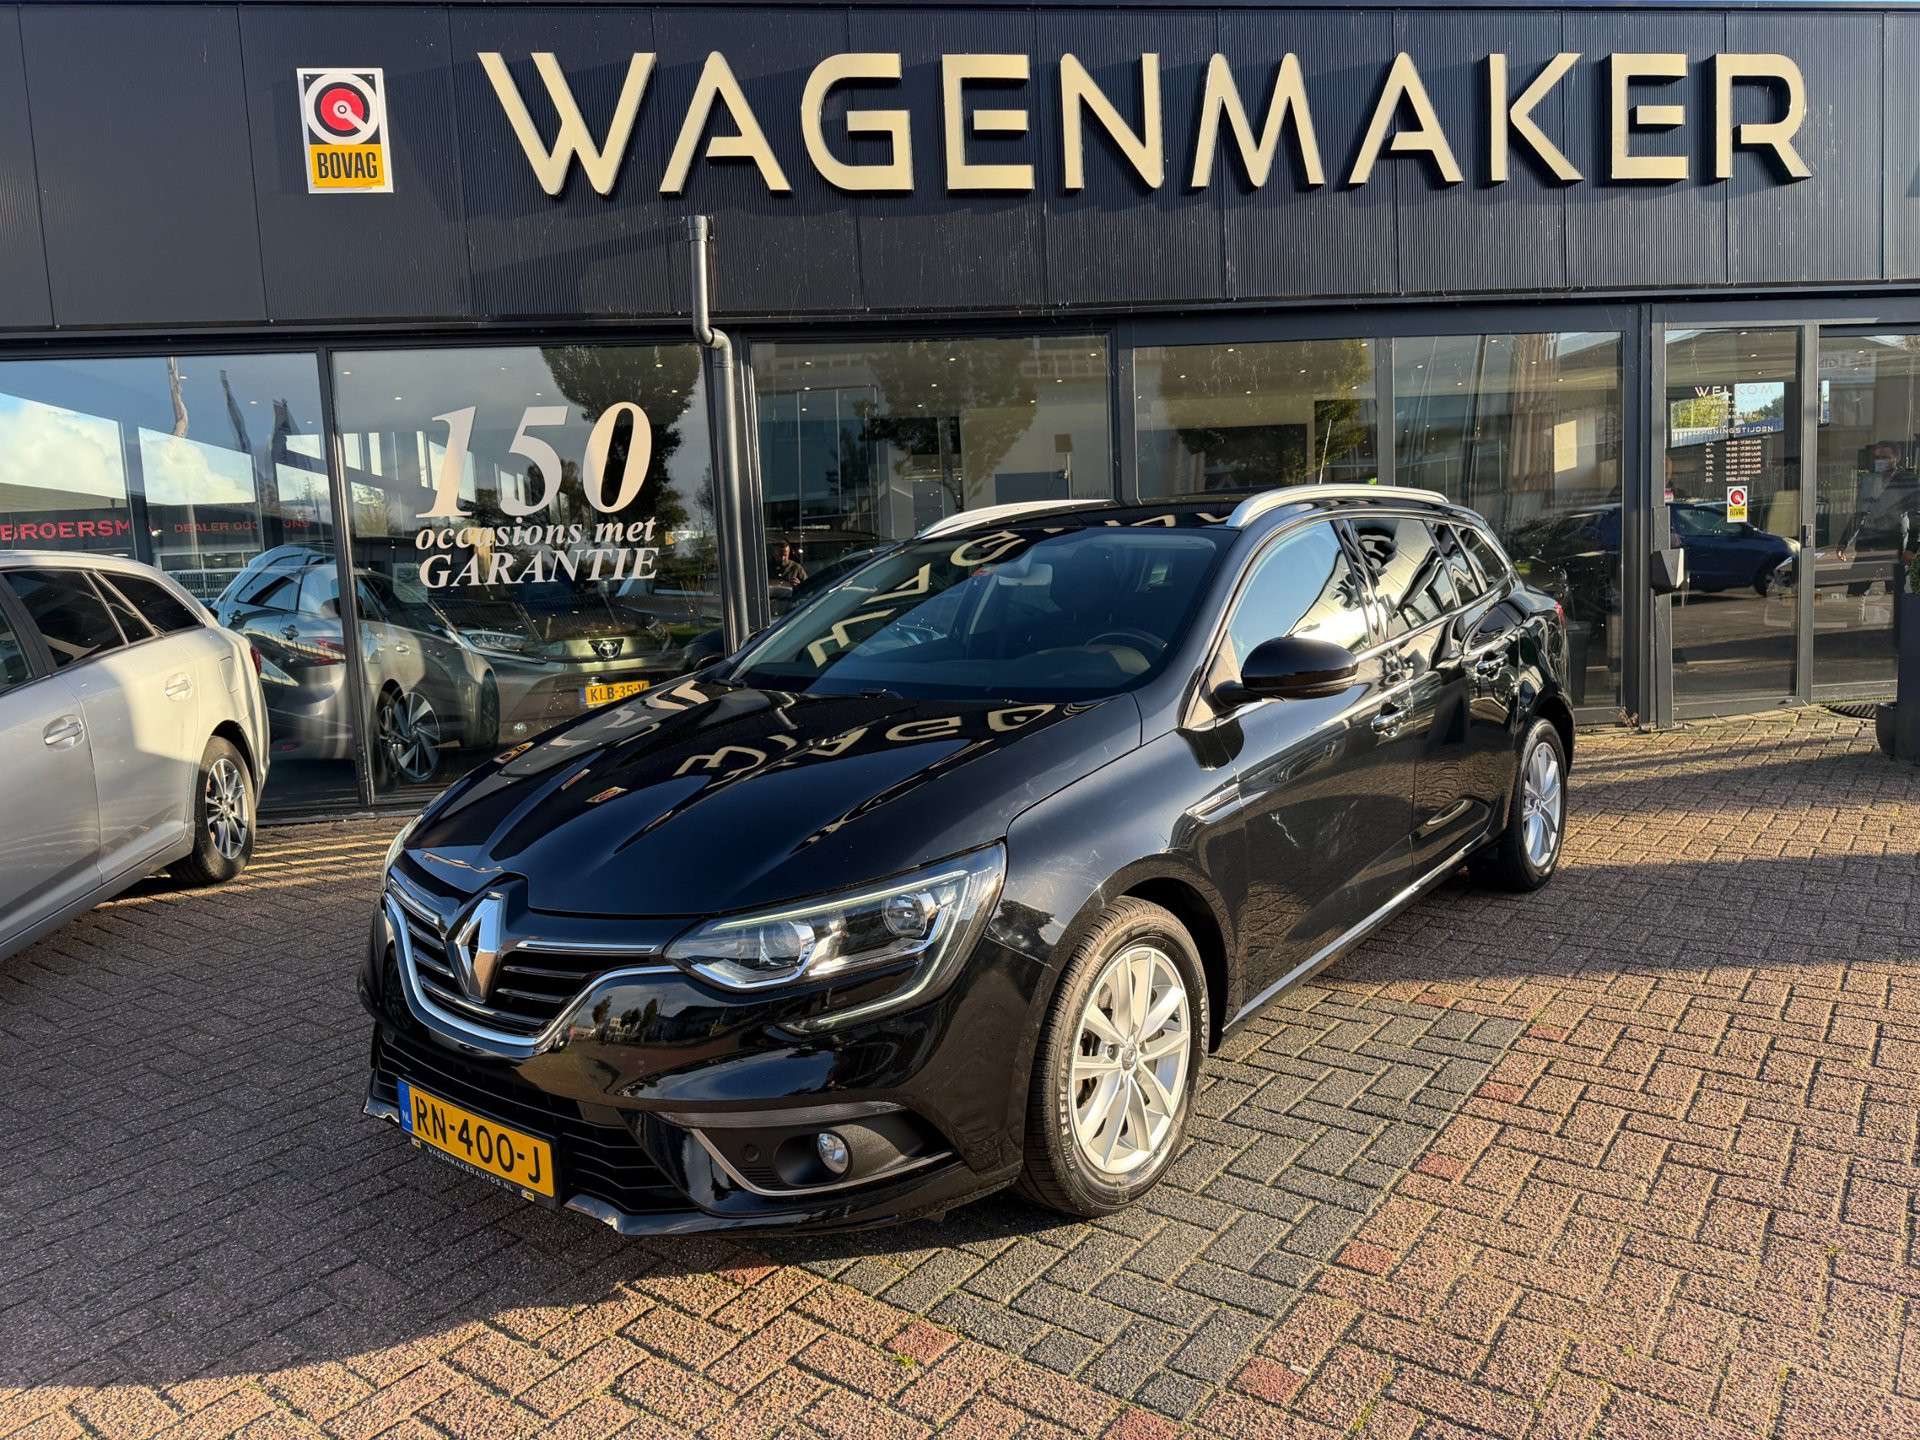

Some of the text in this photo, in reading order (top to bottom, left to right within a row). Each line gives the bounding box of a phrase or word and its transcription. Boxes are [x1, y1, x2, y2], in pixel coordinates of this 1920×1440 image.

[477, 50, 1813, 195] WAGENMAKER
[316, 151, 378, 179] BOVAG
[415, 401, 652, 518] 150
[0, 519, 132, 541] BROERSM
[174, 522, 230, 534] DEALER
[415, 516, 657, 550] occasions met
[418, 547, 660, 589] GARANTIE
[415, 1095, 541, 1184] RN-400-J
